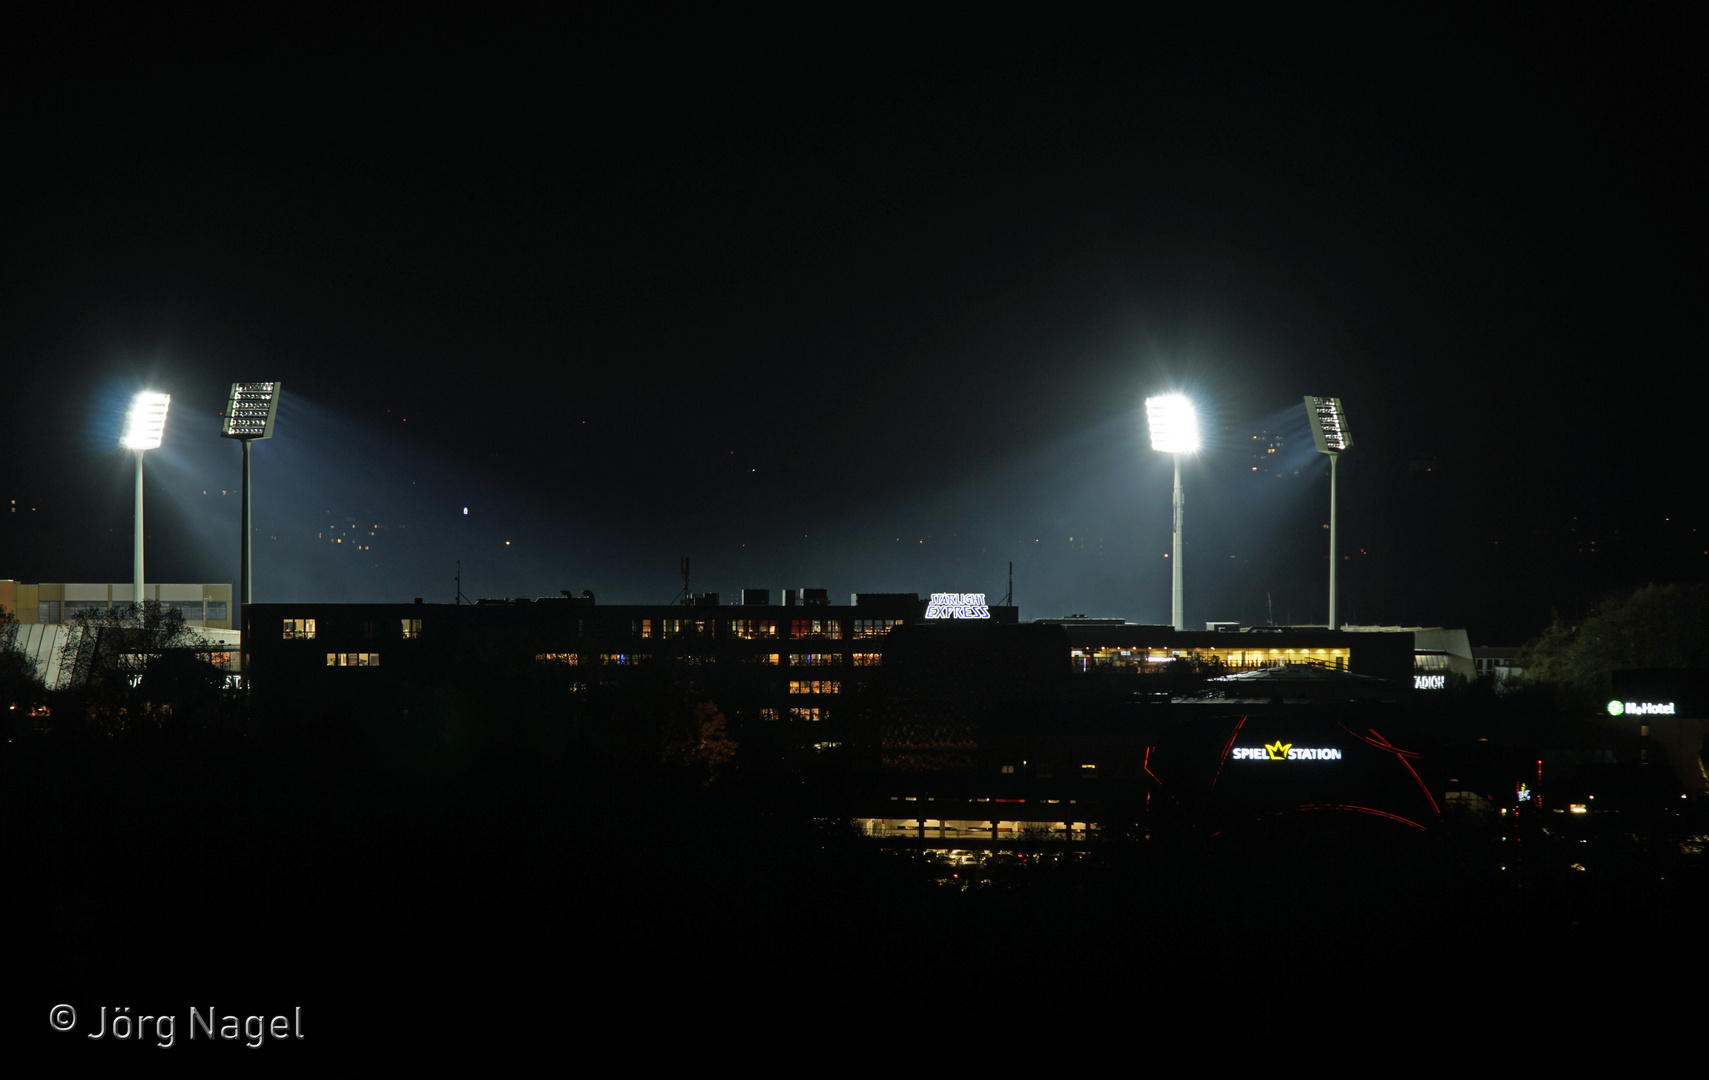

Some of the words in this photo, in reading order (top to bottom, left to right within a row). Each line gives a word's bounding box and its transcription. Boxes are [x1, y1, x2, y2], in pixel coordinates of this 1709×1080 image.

[929, 592, 986, 606] STARLIGHT
[925, 605, 991, 619] EXPRESS
[1232, 747, 1270, 760] SPIEL
[1287, 748, 1342, 760] STATION
